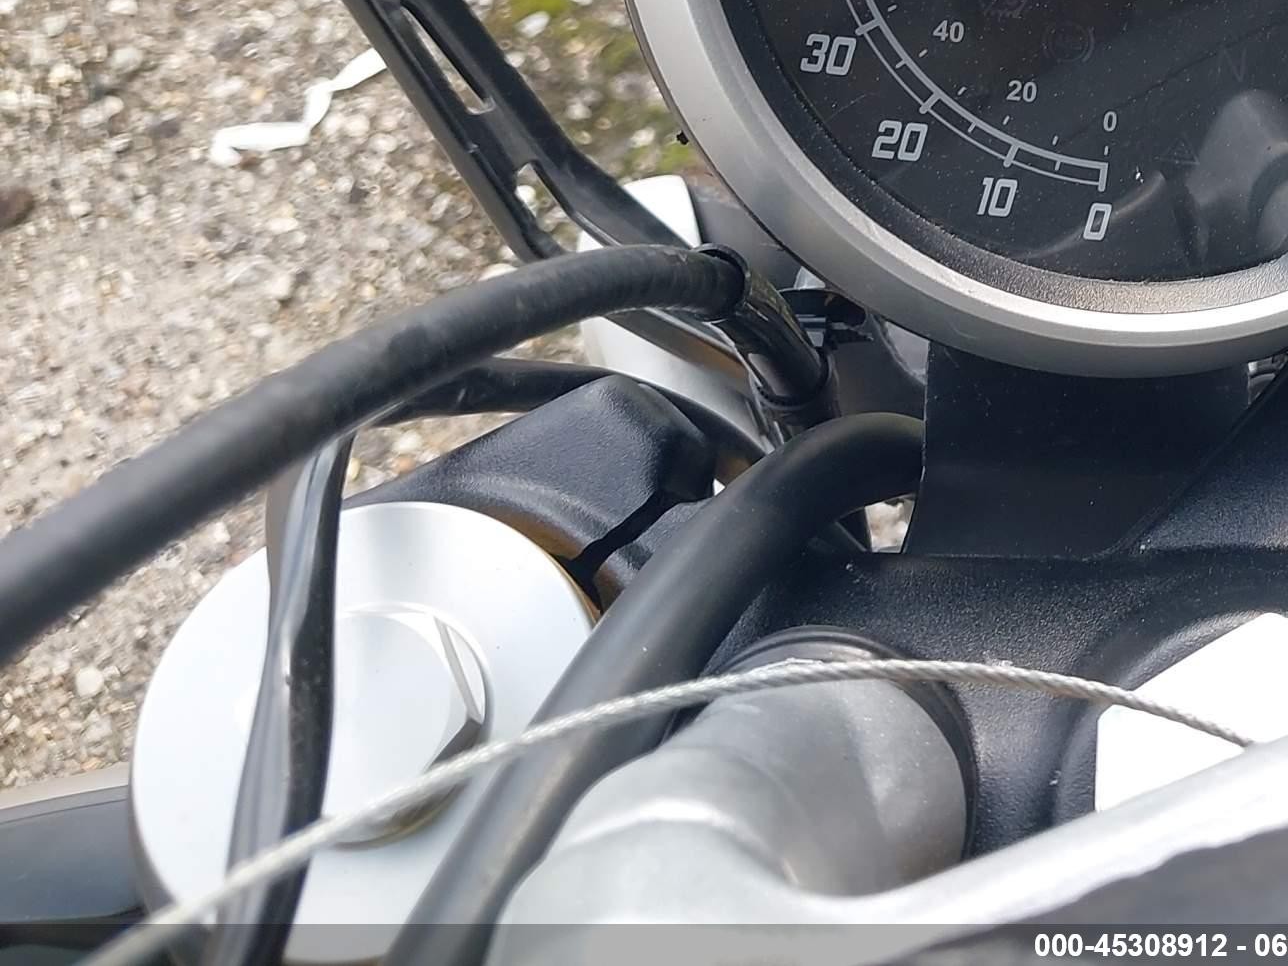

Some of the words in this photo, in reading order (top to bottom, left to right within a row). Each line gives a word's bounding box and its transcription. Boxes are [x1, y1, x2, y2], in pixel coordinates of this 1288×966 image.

[932, 20, 965, 44] 40
[800, 34, 857, 76] 30
[1007, 79, 1038, 103] 20
[1103, 111, 1118, 133] 0
[871, 120, 928, 162] 20
[977, 177, 1018, 218] 10
[1083, 203, 1113, 240] 0
